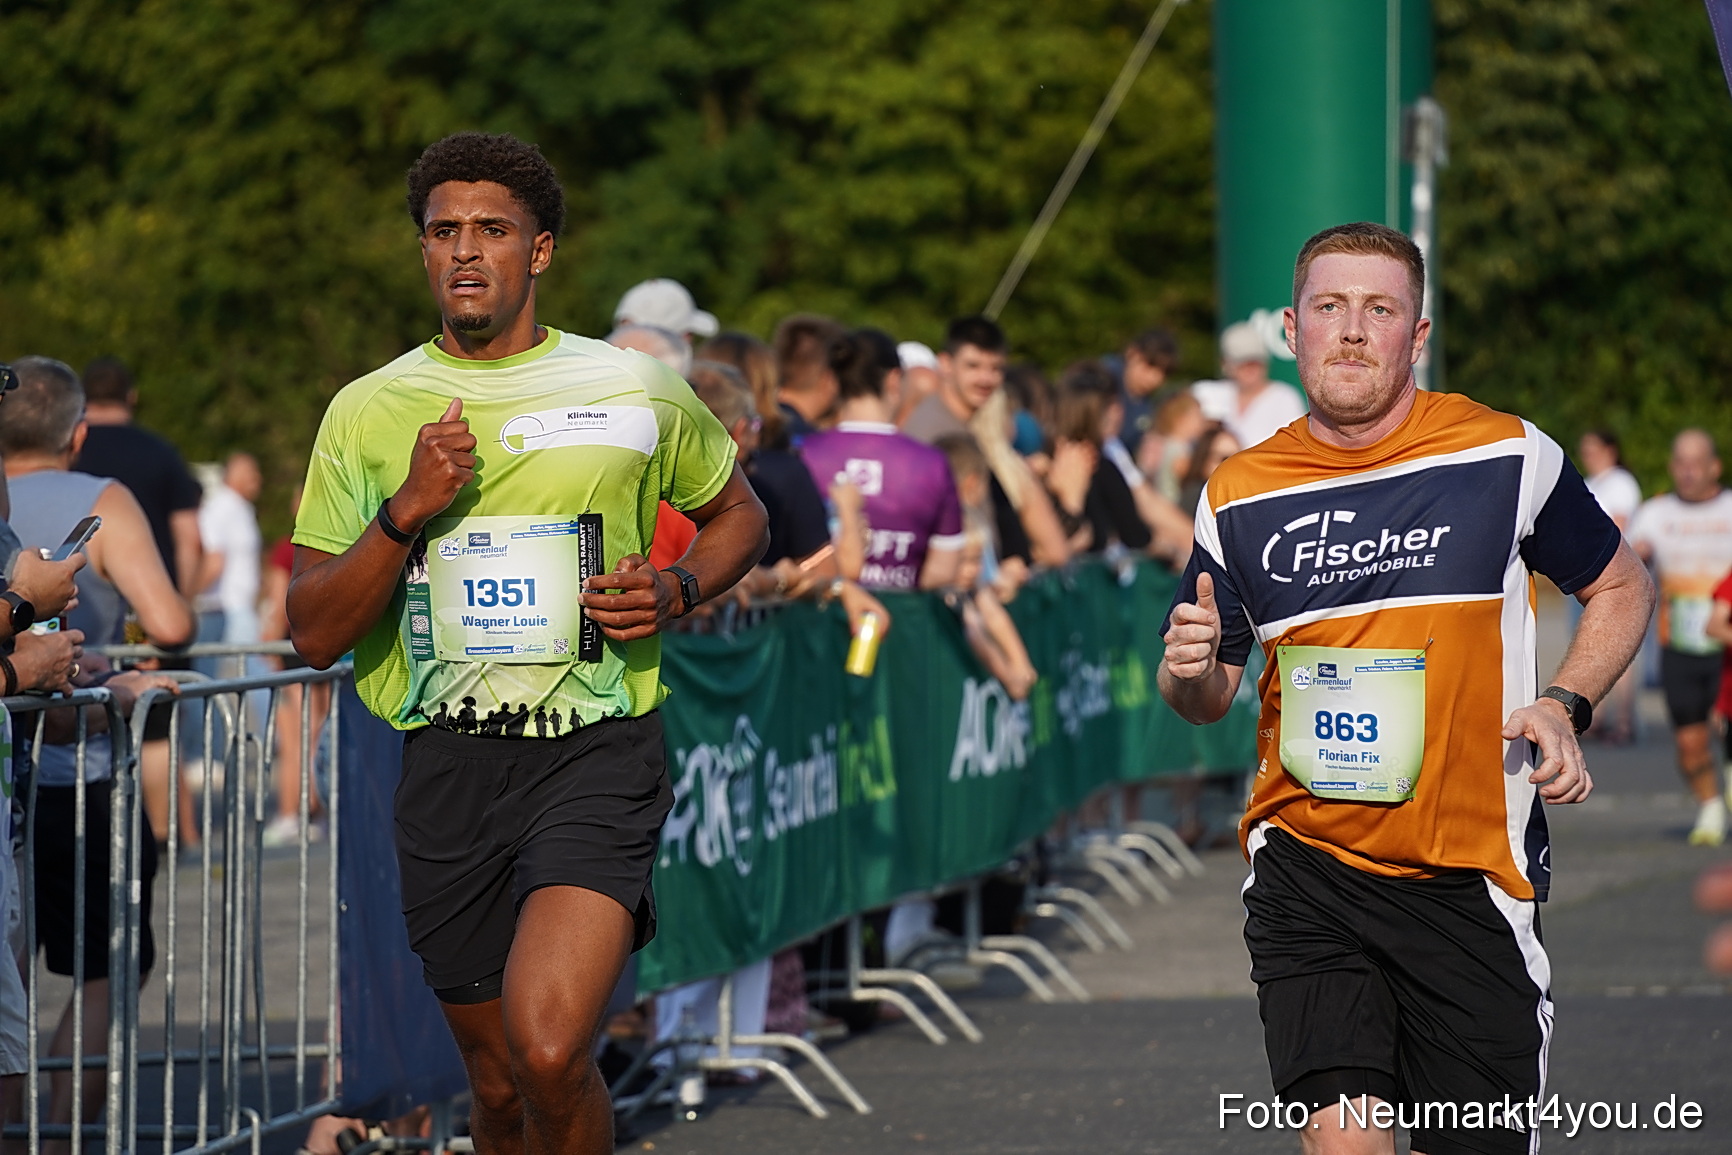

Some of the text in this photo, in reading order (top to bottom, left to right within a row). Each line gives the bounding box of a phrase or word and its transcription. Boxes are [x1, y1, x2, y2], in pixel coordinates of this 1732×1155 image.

[567, 411, 608, 420] Klinikum
[462, 545, 508, 555] Firmenlauf
[1292, 525, 1451, 572] Fischer
[580, 566, 586, 578] 20
[1306, 554, 1436, 588] AUTOMOBILE
[462, 578, 535, 607] 1351
[461, 615, 548, 629] Wagner Louie
[584, 616, 592, 650] HILT
[1315, 710, 1378, 742] 863
[1318, 749, 1380, 763] Florian Fix
